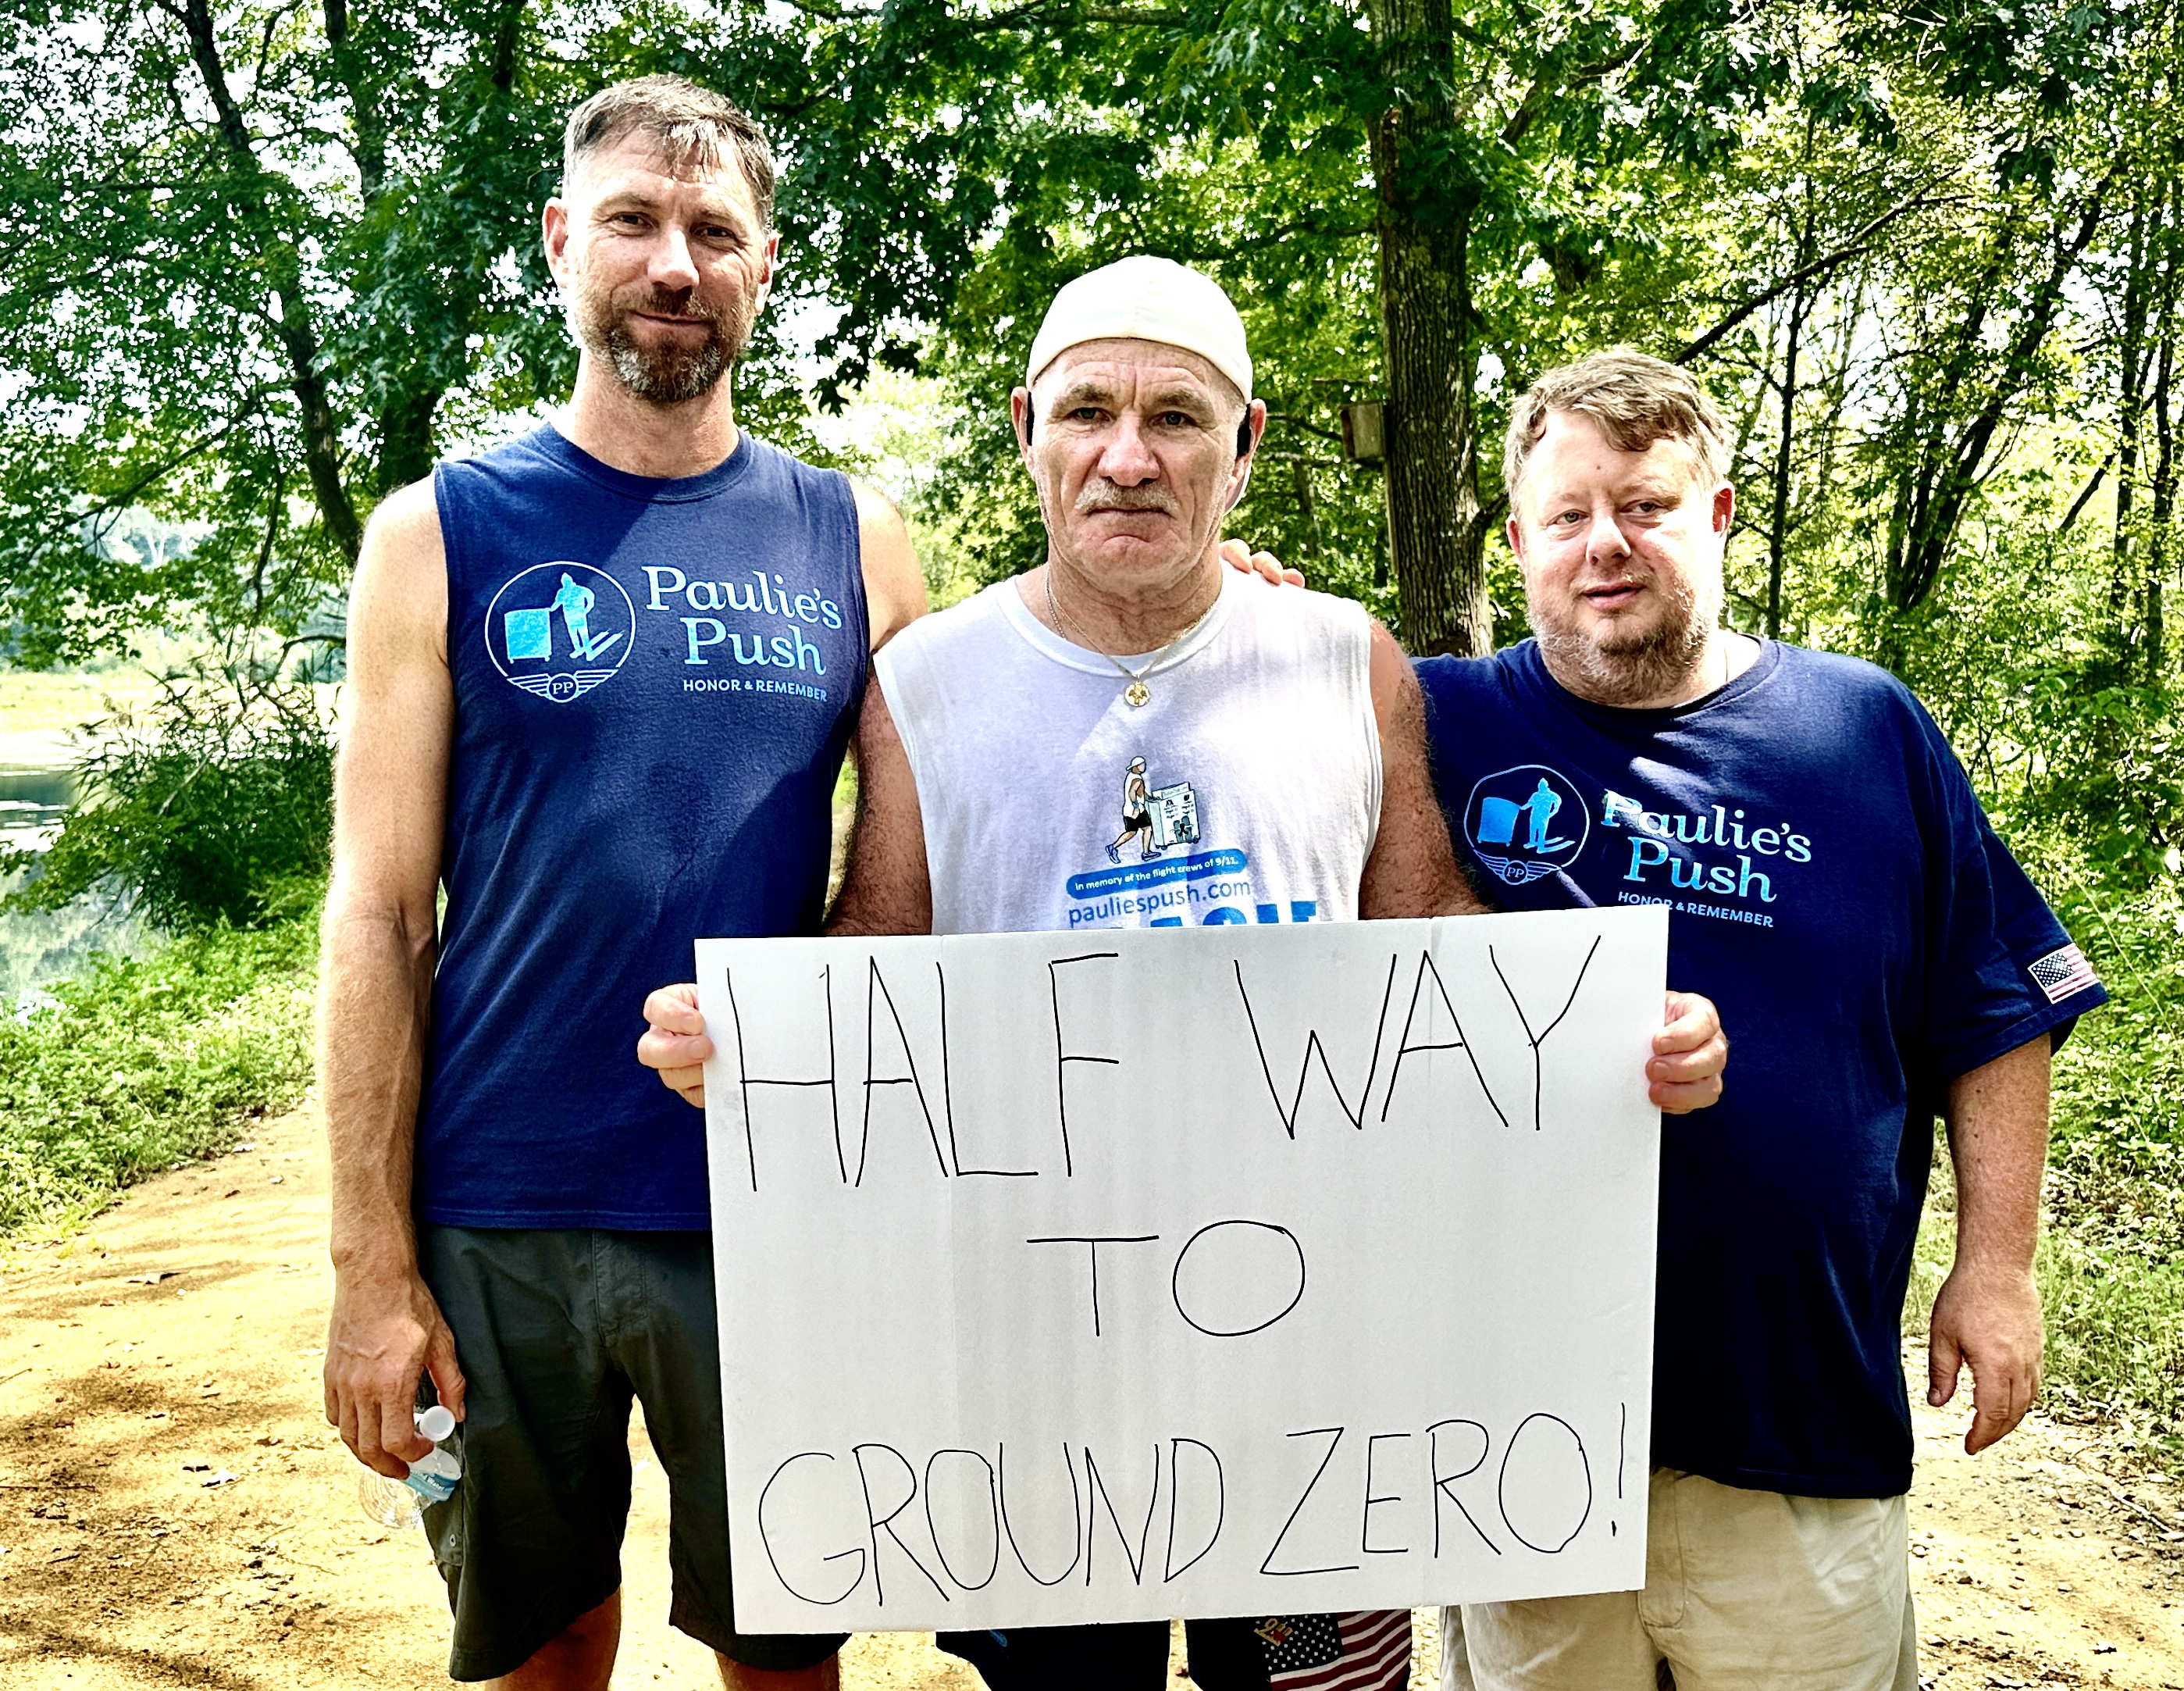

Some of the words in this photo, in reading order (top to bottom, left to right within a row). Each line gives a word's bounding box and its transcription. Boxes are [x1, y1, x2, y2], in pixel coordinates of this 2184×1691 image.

[641, 565, 842, 630] Paulie's
[680, 617, 827, 676] Push
[552, 681, 574, 694] PP
[683, 679, 741, 691] HONOR
[744, 681, 754, 690] &
[756, 680, 828, 702] REMEMBER
[1600, 789, 1812, 862] Paulie's
[1086, 876, 1122, 890] memory
[1124, 873, 1135, 883] of
[1135, 872, 1151, 881] the
[1153, 866, 1176, 877] flight
[1178, 864, 1203, 873] crews
[1204, 858, 1213, 868] of
[1506, 867, 1524, 878] PP
[1623, 836, 1777, 902] Push
[1068, 882, 1251, 928] pauliespush.com
[1676, 902, 1685, 911] &
[1687, 903, 1774, 928] REMEMBER
[726, 954, 1120, 1193] HALF
[1234, 934, 1601, 1140] WAY
[1027, 1220, 1305, 1337] TO
[758, 1438, 1224, 1607] GROUND
[1259, 1402, 1626, 1576] ZERO!
